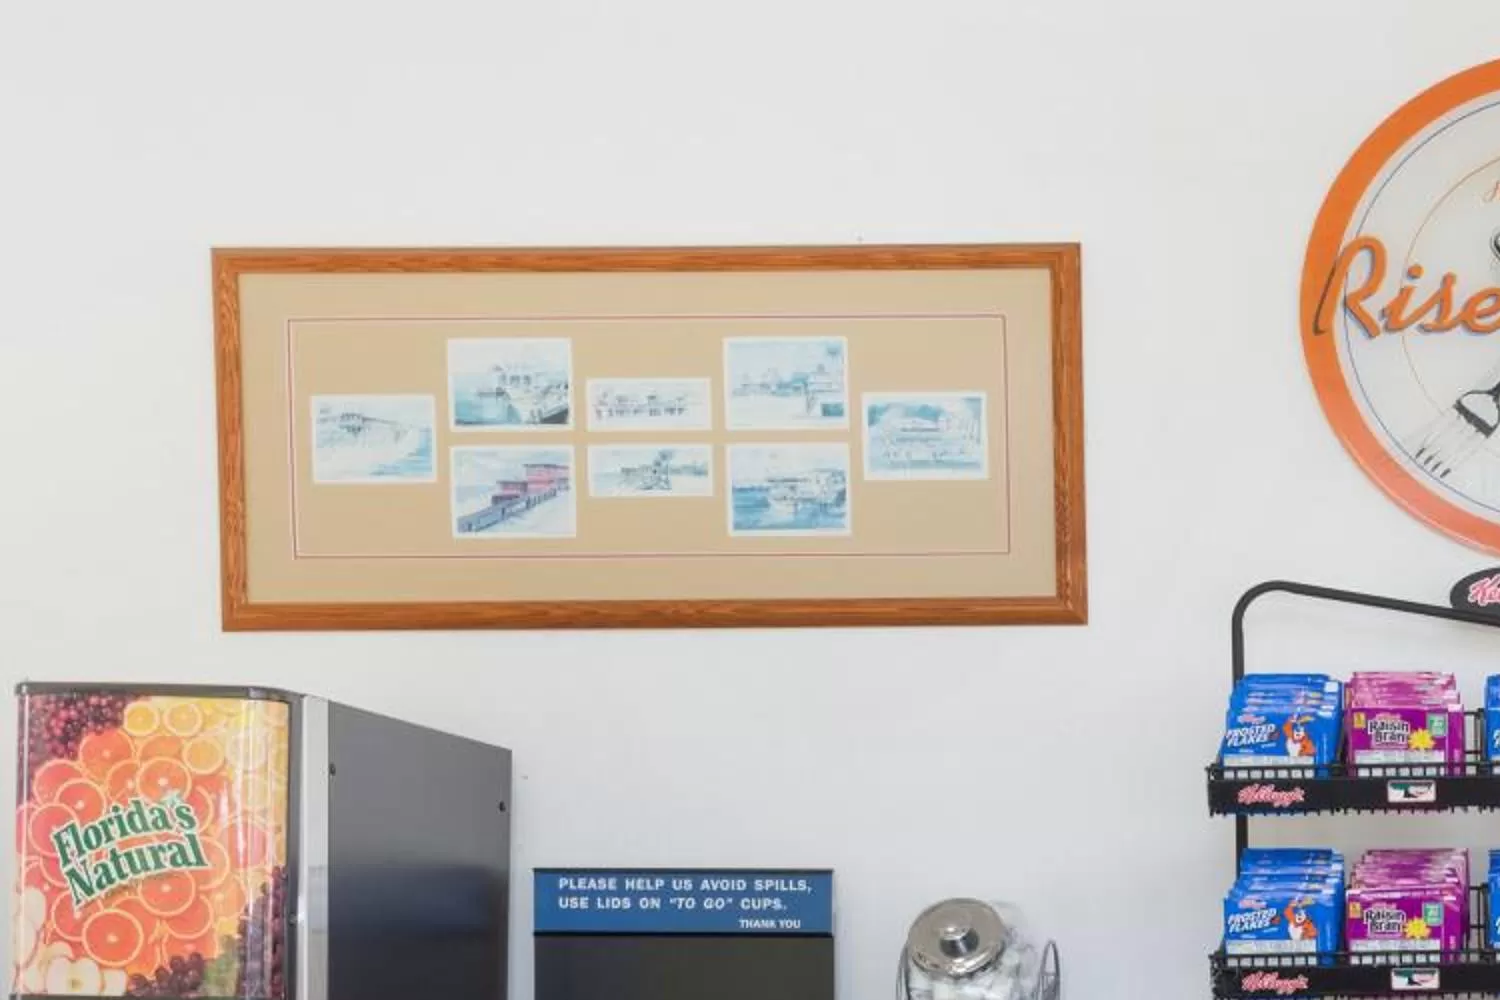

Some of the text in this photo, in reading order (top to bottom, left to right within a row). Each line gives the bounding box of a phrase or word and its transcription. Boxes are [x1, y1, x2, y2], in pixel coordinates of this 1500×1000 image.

[53, 790, 197, 868] Florida's
[64, 832, 209, 905] Natural
[558, 878, 617, 891] PLEASE
[625, 878, 665, 891] HELP
[672, 879, 693, 891] US
[700, 879, 747, 891] AVOID
[558, 897, 589, 909] USE
[597, 897, 631, 909] LIDS
[639, 897, 661, 909] ON
[740, 898, 787, 910] CUPS.
[739, 919, 801, 929] THANK YOU
